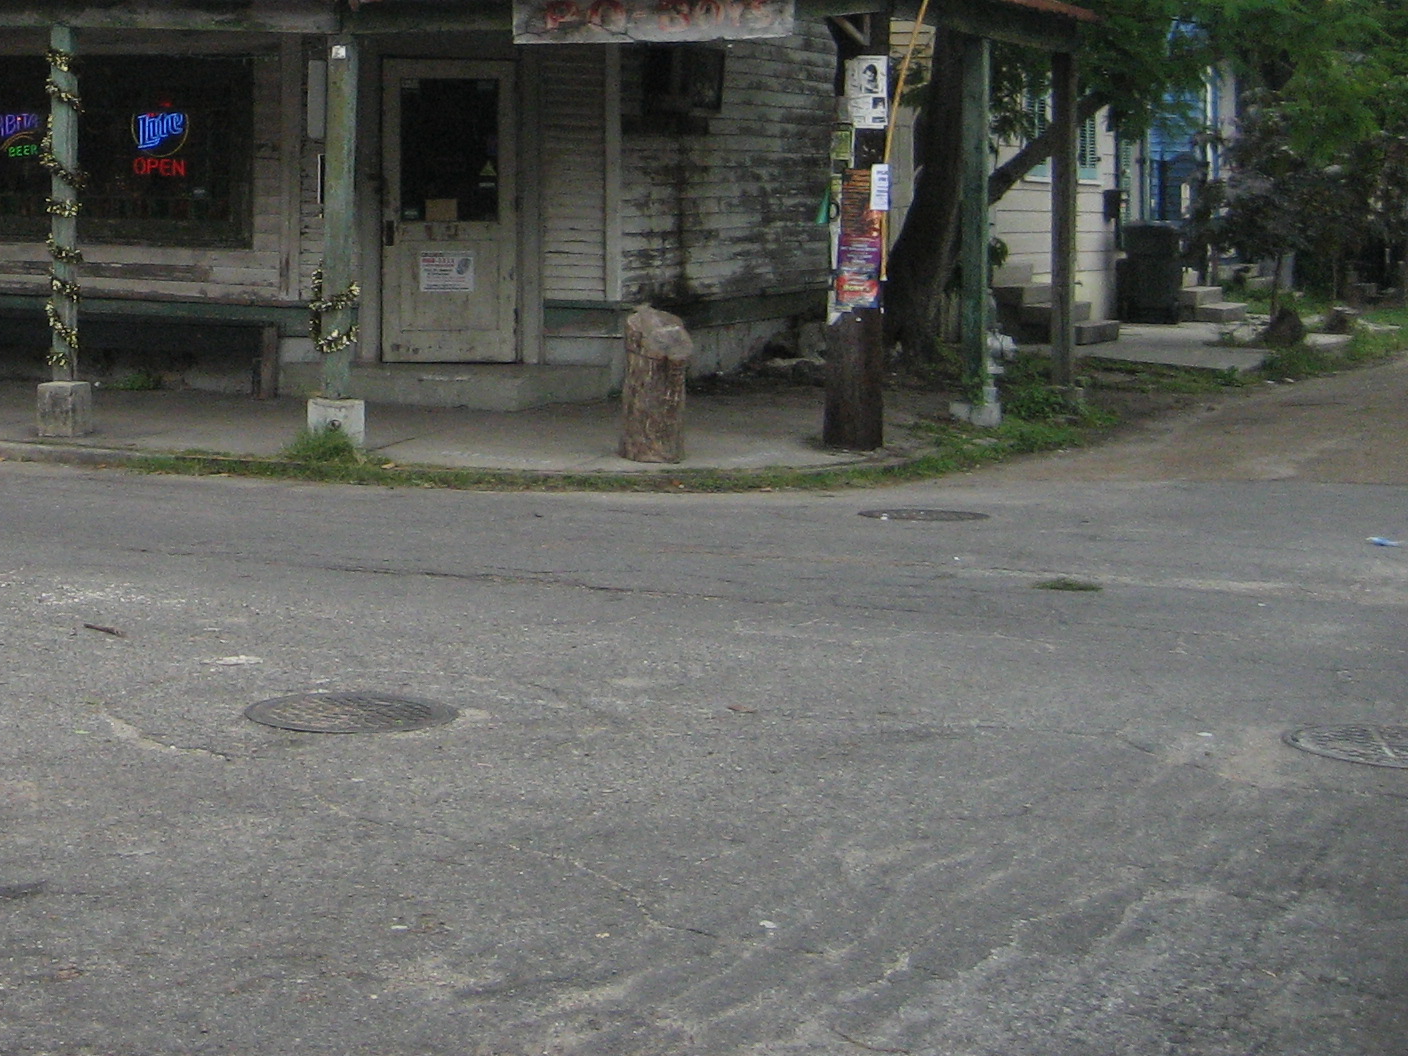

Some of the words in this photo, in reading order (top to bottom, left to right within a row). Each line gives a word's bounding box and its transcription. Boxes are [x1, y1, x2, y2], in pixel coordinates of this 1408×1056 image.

[137, 112, 185, 149] Lite
[8, 145, 38, 158] BEER
[133, 157, 187, 176] OPEN
